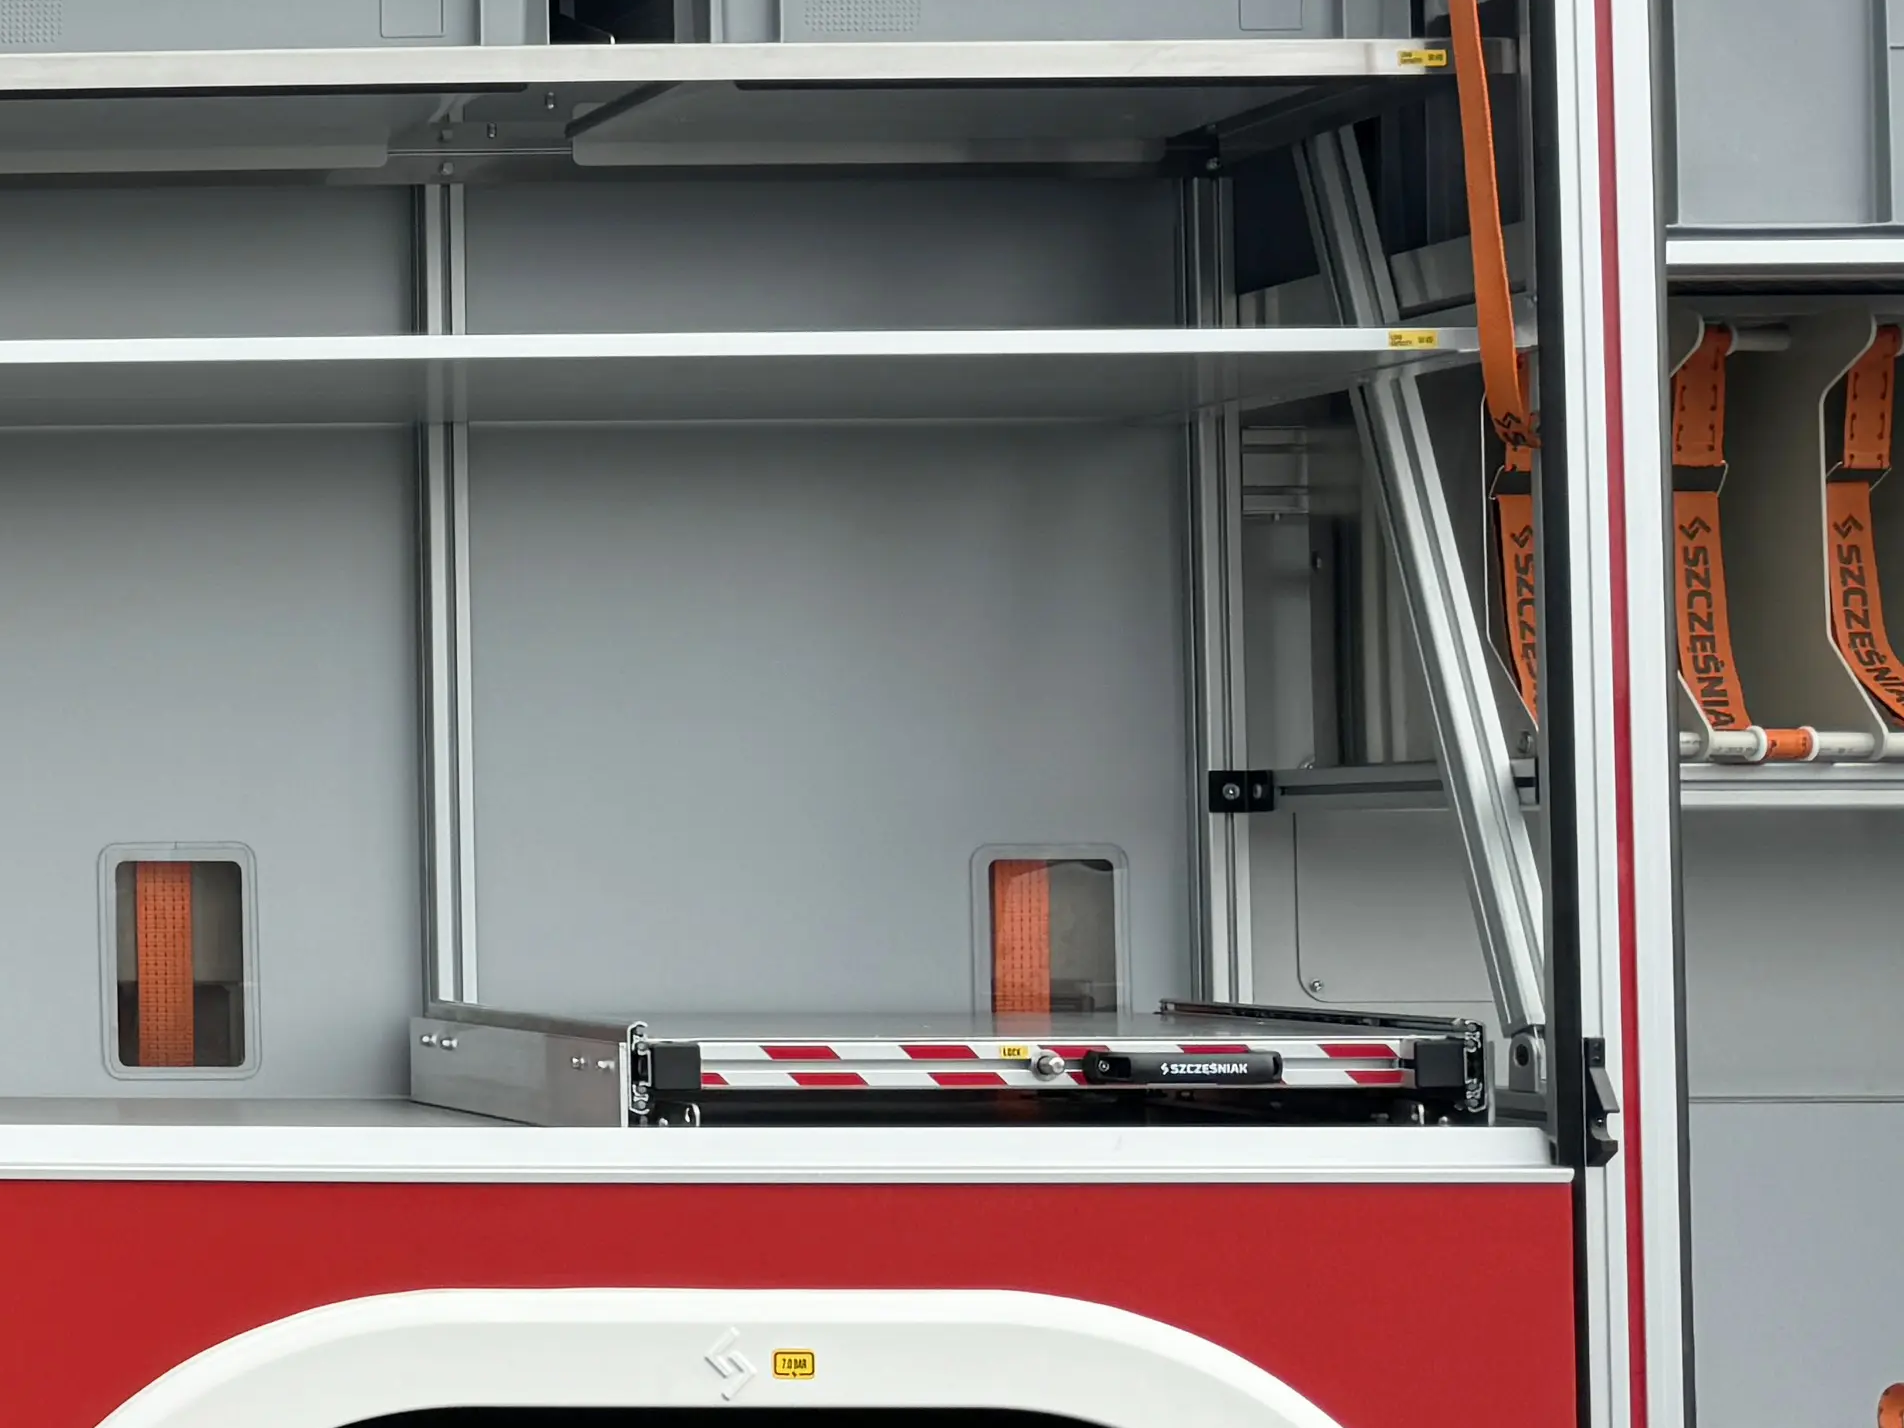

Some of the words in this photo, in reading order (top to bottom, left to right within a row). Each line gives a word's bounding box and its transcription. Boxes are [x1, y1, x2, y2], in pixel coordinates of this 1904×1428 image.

[1682, 545, 1736, 730] SZCZĘŚNIA
[1003, 1047, 1022, 1057] LOCK
[1170, 1062, 1248, 1076] SZCZĘŚNIAK
